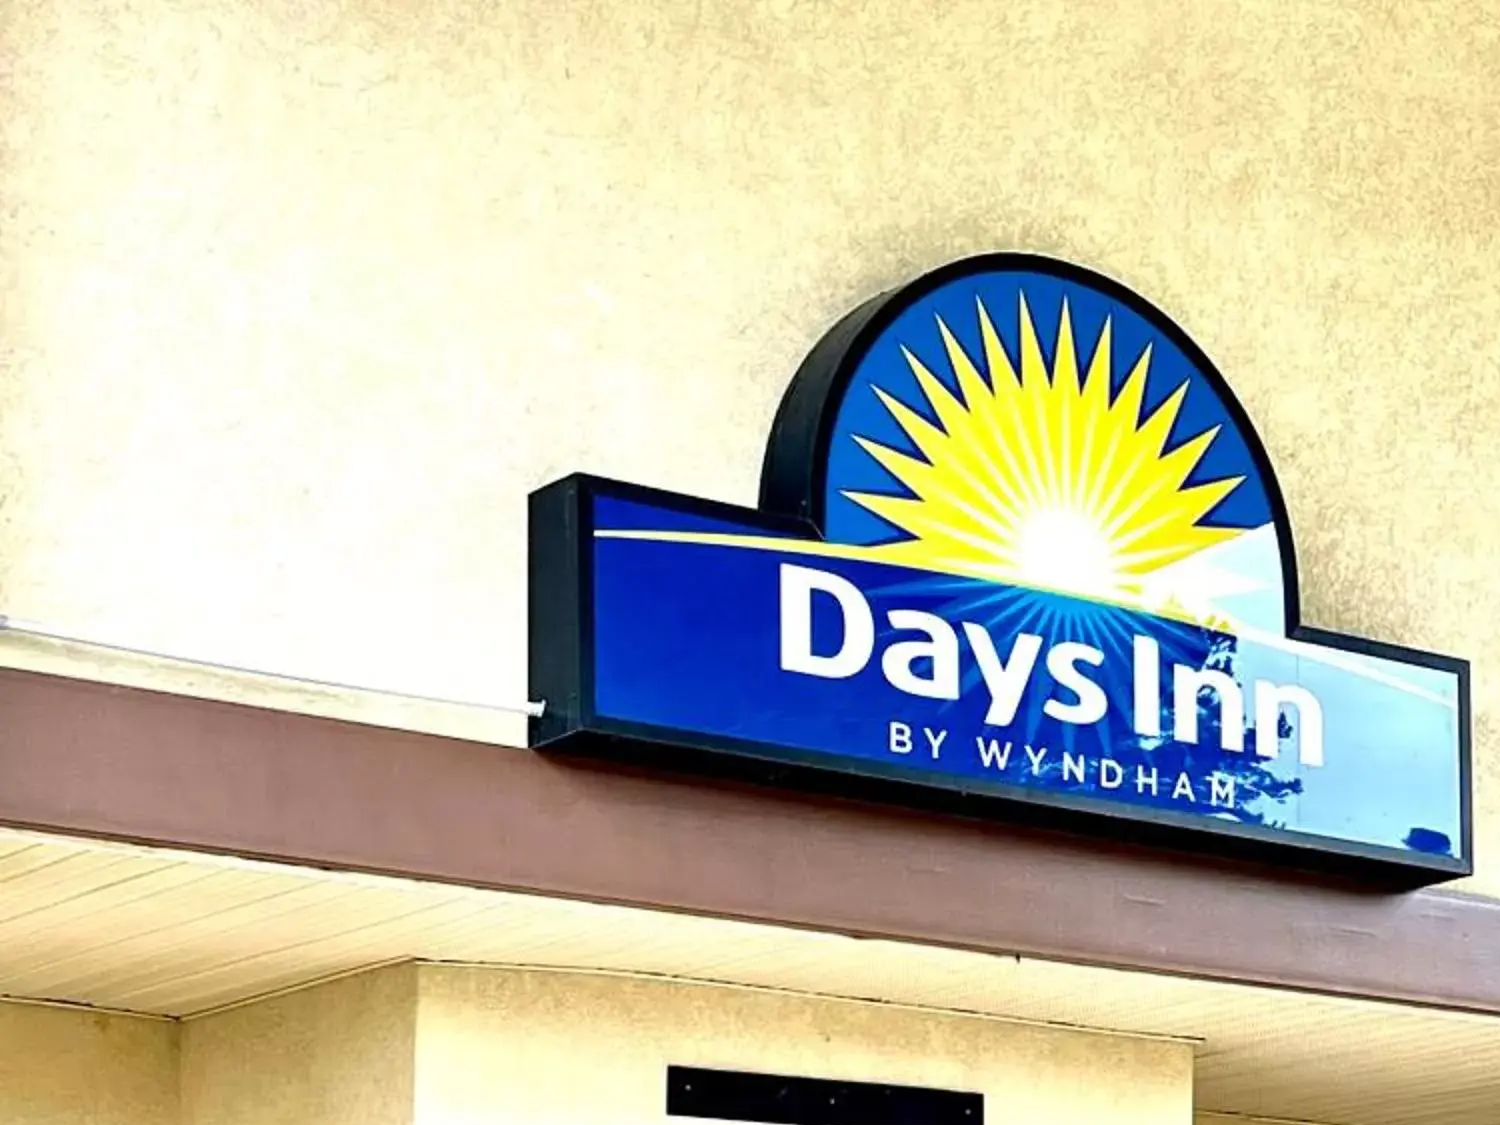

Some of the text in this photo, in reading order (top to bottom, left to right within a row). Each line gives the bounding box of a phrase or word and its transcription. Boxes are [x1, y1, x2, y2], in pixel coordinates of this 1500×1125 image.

[780, 563, 1324, 767] Days Inn
[889, 721, 1236, 808] BY WYNDHAM
